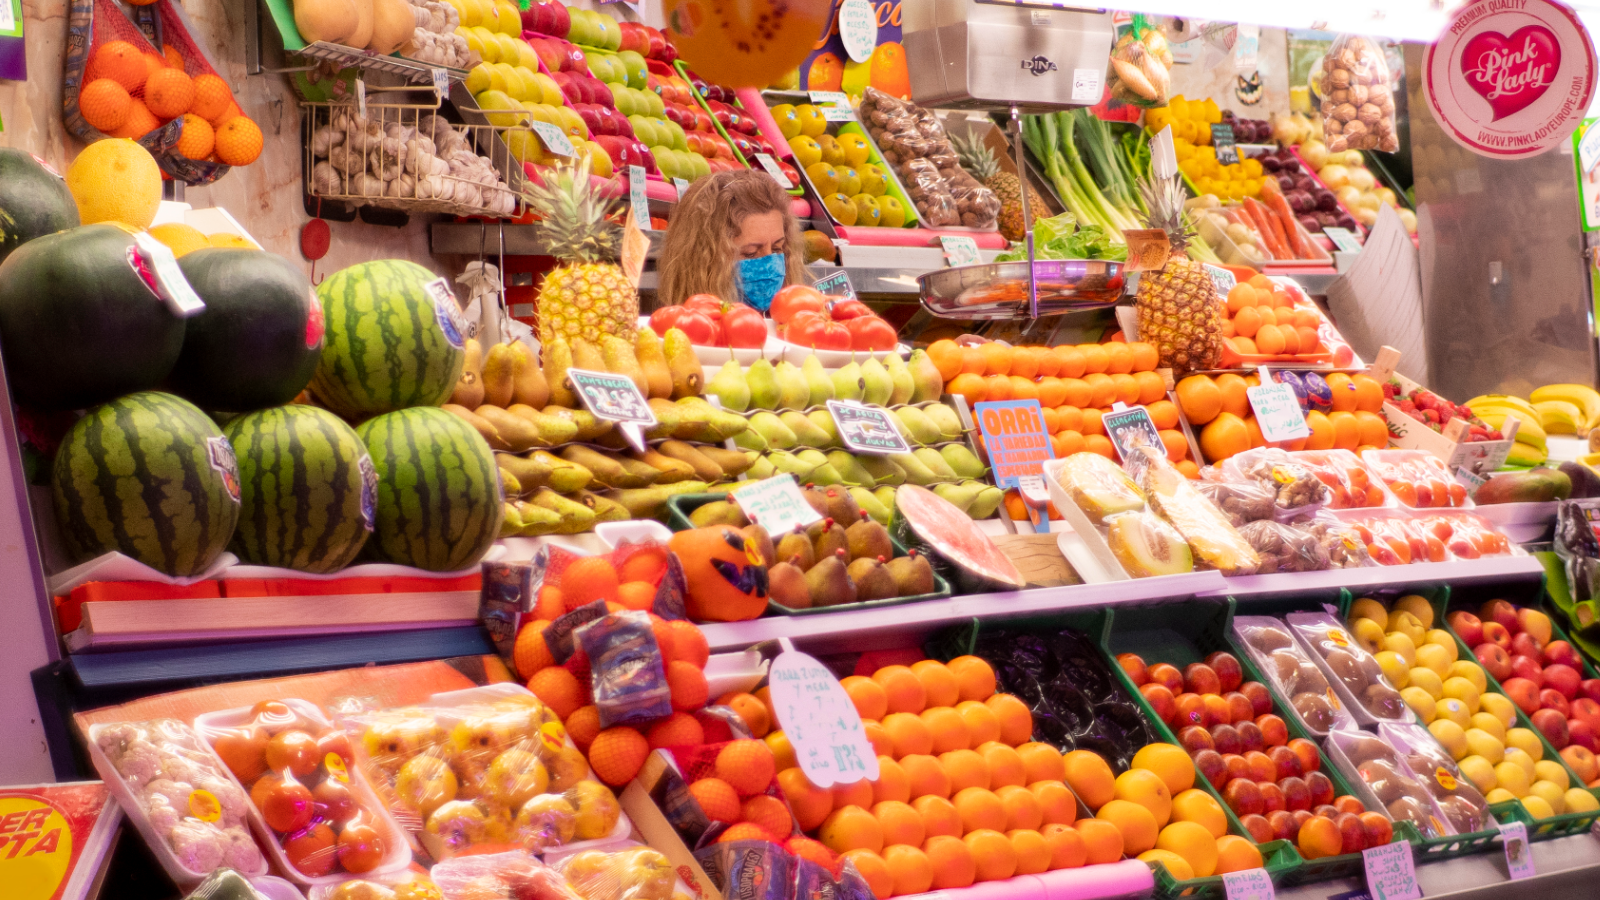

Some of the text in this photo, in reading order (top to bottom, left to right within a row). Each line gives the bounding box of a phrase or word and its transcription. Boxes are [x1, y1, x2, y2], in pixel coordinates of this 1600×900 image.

[1450, 0, 1527, 35] PREMIUM QUALITY
[1021, 59, 1058, 71] DINA
[1467, 35, 1538, 82] Pink
[1477, 75, 1584, 147] WWW.PINKLADYEUROPE.COM
[0, 807, 54, 835] ER
